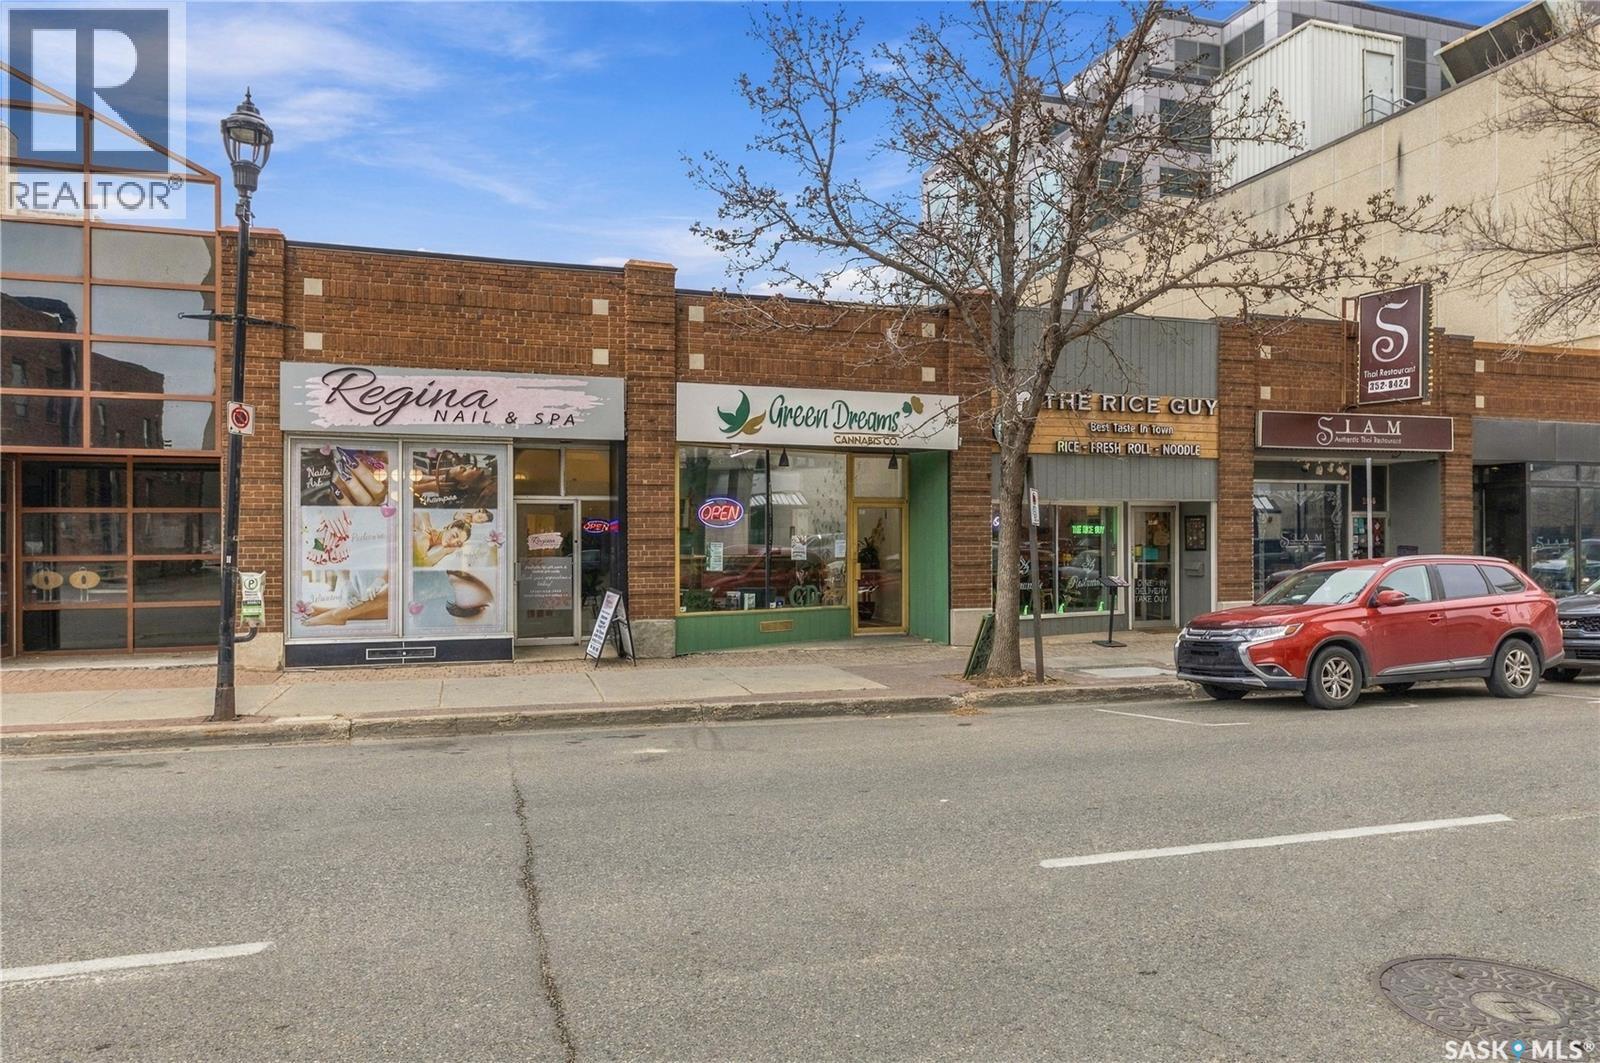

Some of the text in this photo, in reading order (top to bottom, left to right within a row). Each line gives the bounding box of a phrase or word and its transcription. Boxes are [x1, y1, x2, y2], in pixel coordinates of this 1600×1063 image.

[1371, 299, 1409, 363] S
[1364, 365, 1416, 378] Thai Restaurant
[1369, 378, 1409, 391] 352-8424
[322, 367, 498, 427] Regina
[1044, 393, 1219, 416] THE RICE GUY
[434, 409, 576, 426] NAIL & SPA
[769, 394, 829, 429] Green
[1090, 422, 1174, 435] Best Taste In Town
[1316, 416, 1402, 446] SIAM
[834, 435, 900, 446] CANNABIS CO.
[1057, 440, 1080, 453] RICE
[1090, 442, 1121, 454] FRESH
[1127, 443, 1153, 455] ROLL
[1162, 444, 1201, 456] NOODLE
[306, 465, 331, 478] Nails
[306, 477, 324, 488] Art
[701, 505, 740, 521] OPEN
[1280, 531, 1322, 548] SIAM
